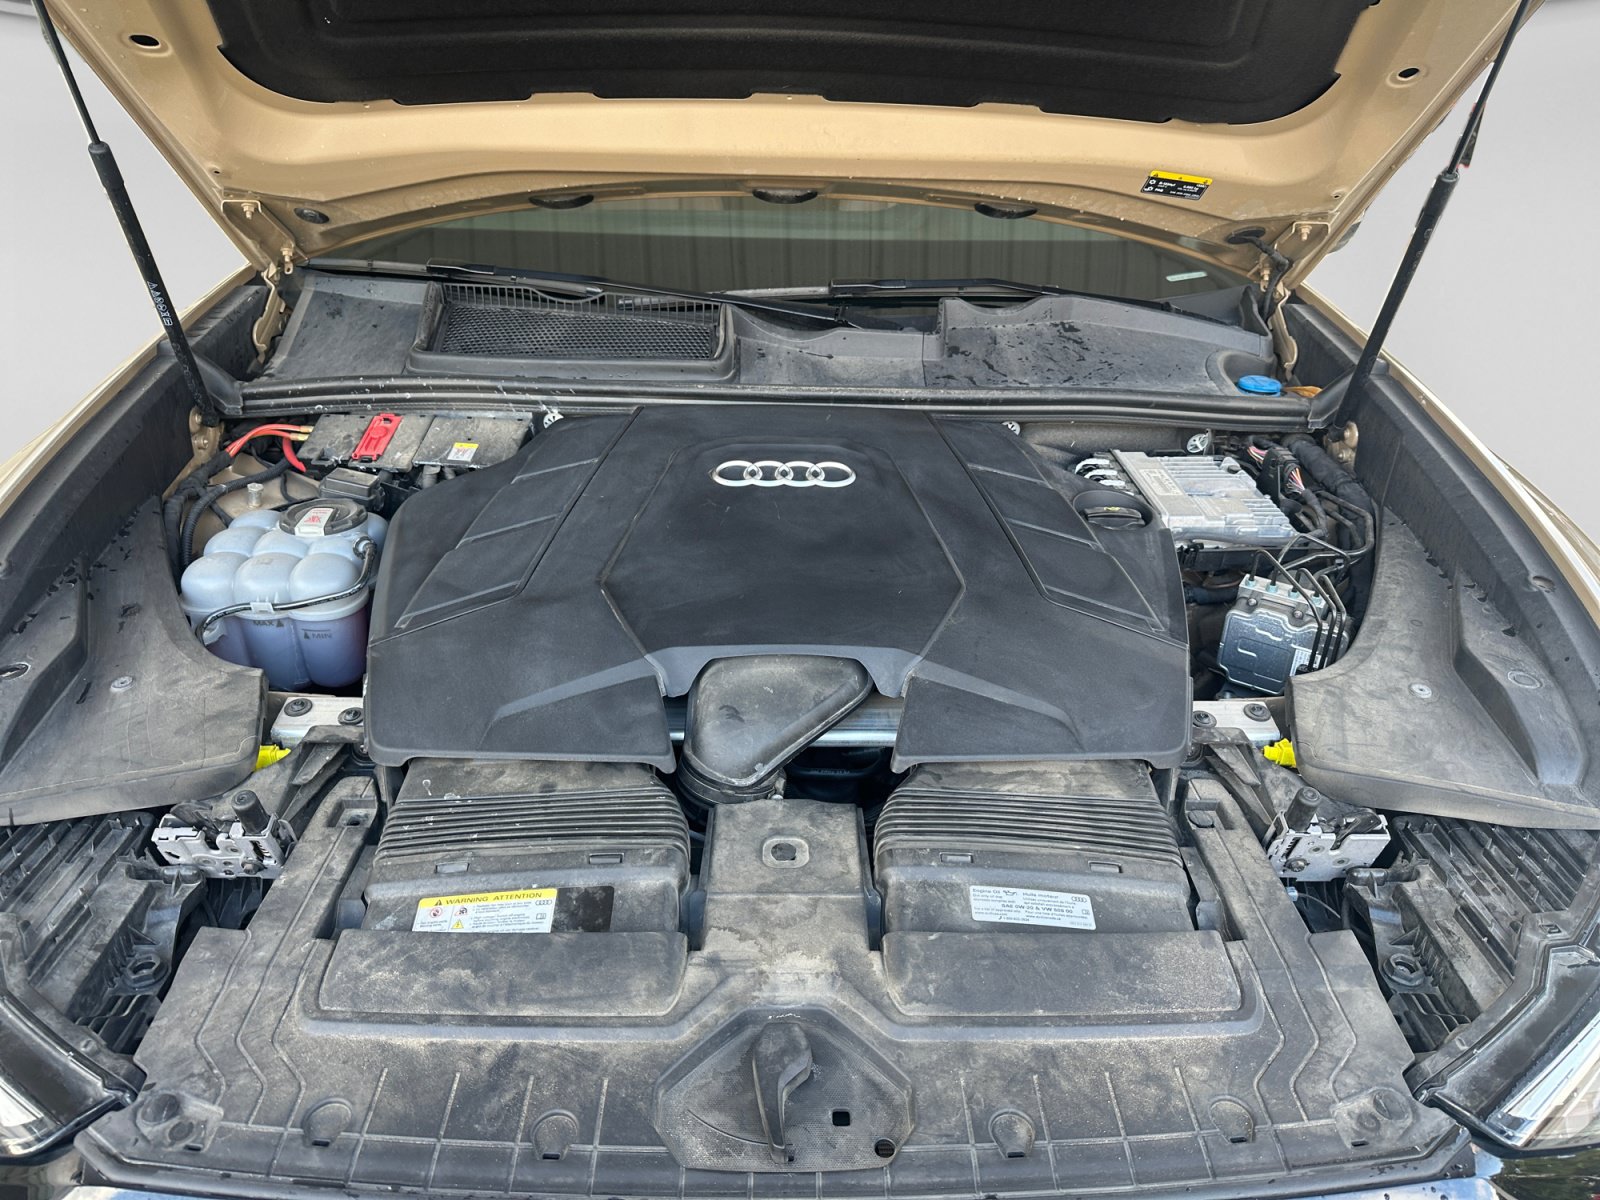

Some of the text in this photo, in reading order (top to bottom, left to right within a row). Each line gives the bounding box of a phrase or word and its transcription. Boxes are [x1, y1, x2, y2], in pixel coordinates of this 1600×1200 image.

[253, 619, 275, 627] MAX
[446, 892, 542, 905] WARNING ATTENTION
